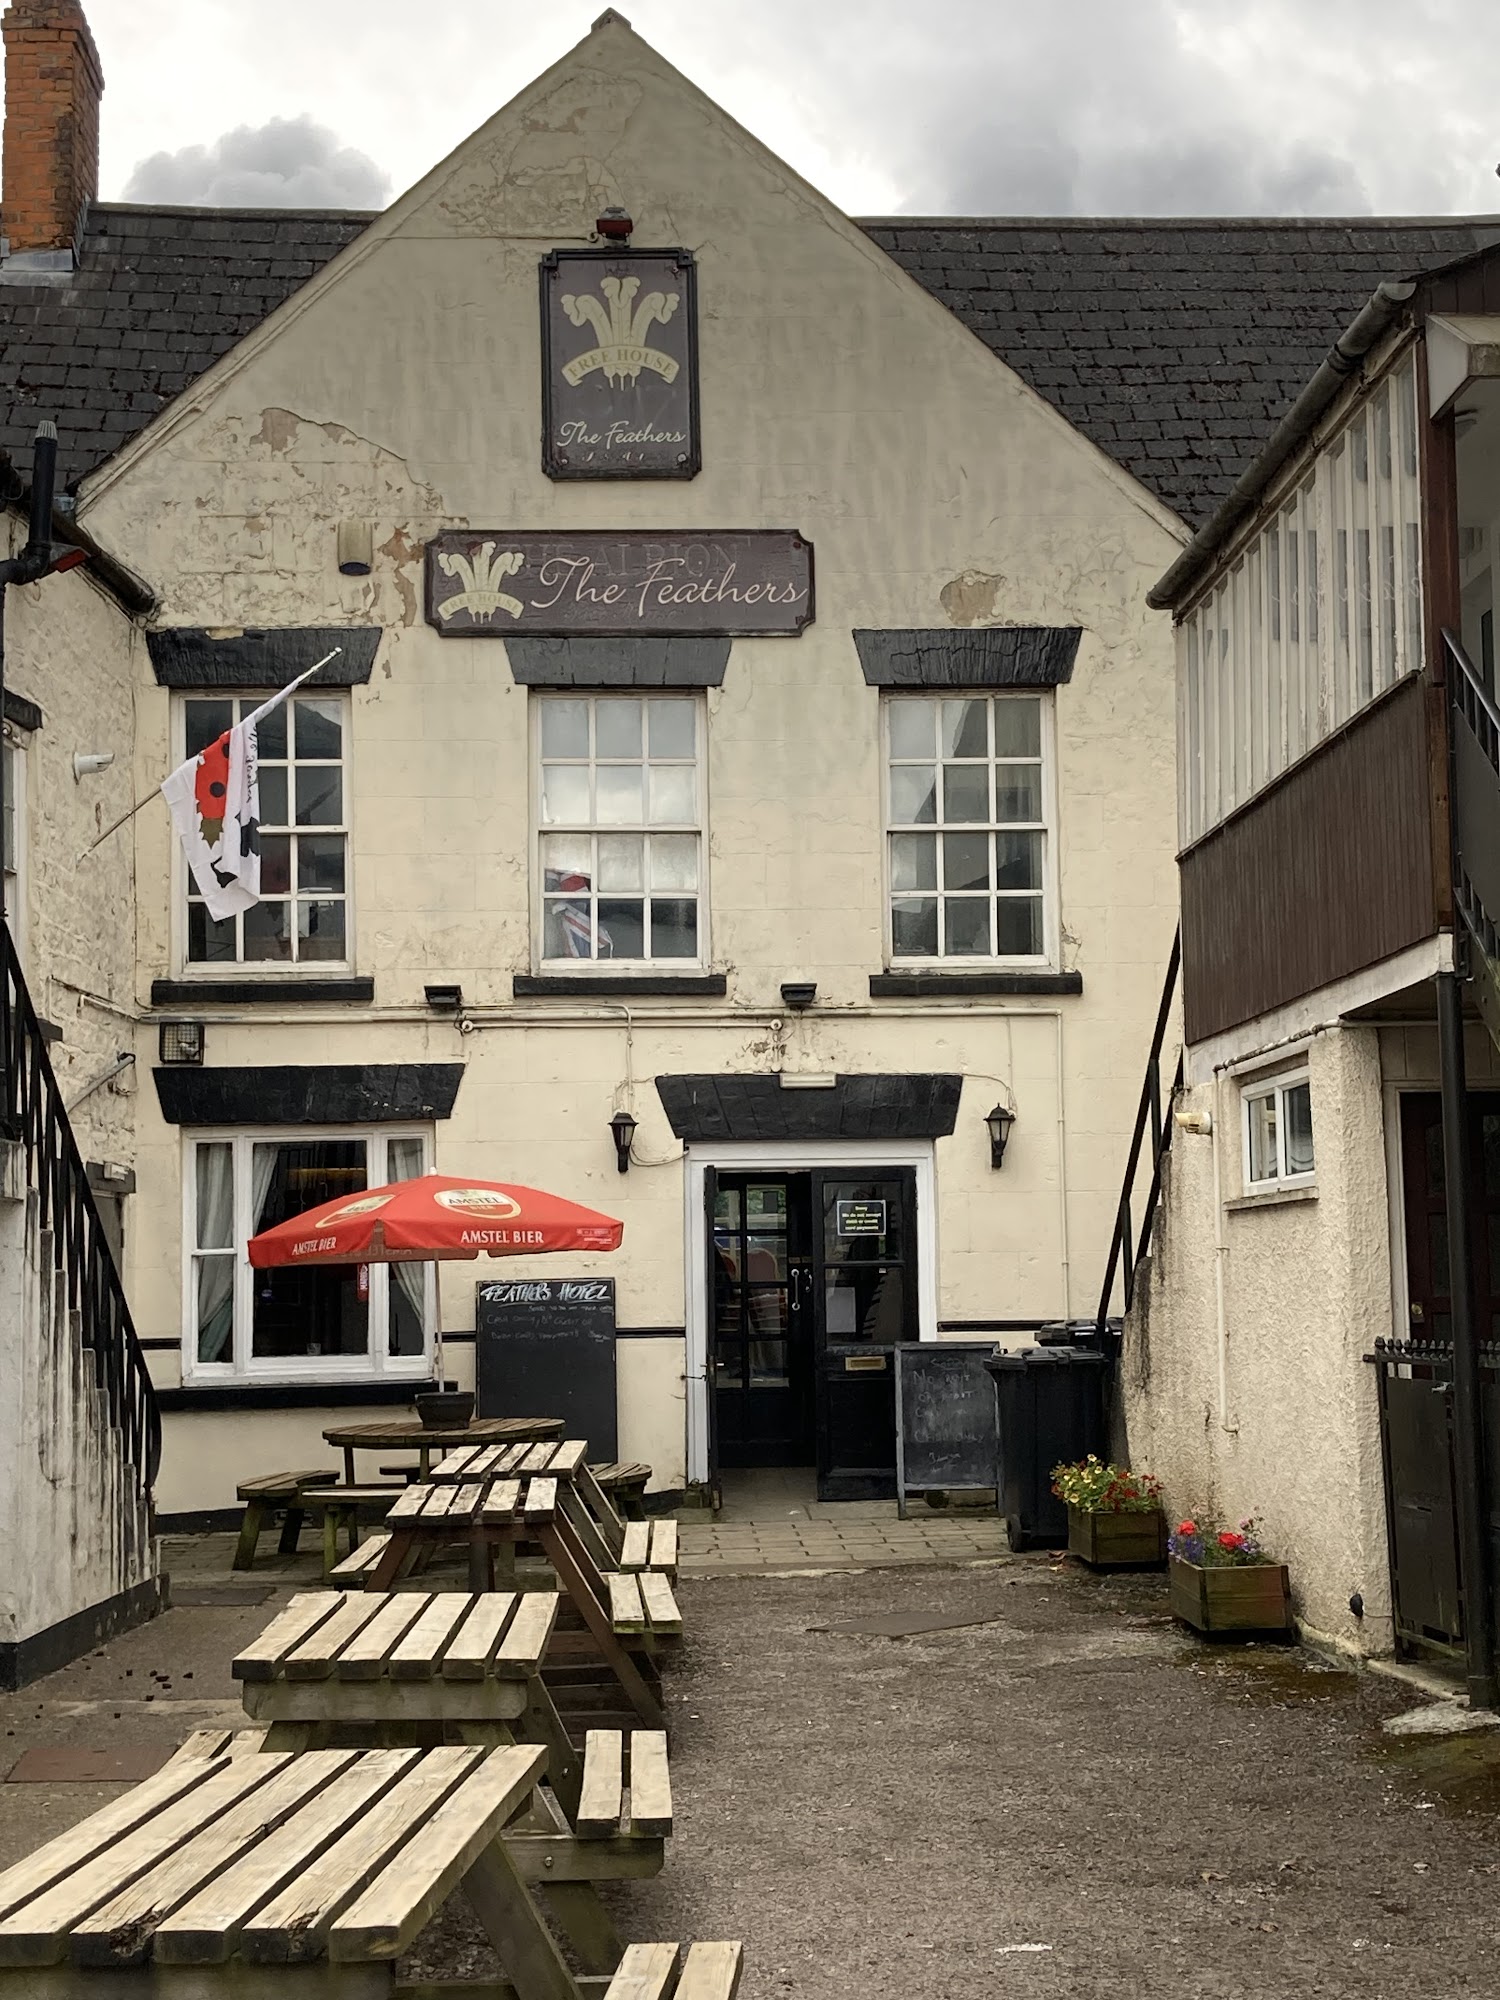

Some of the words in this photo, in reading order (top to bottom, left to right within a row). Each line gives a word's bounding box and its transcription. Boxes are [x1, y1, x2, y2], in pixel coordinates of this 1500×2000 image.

[567, 350, 611, 378] FREE
[617, 349, 676, 378] HOUSE
[556, 420, 602, 447] The
[605, 420, 686, 450] Feathers
[530, 556, 627, 609] The
[635, 557, 809, 618] Feathers
[443, 593, 475, 615] FREE
[478, 592, 521, 615] HOUSE
[448, 1196, 504, 1205] AMSTEL
[291, 1239, 318, 1256] AMSTEL
[318, 1236, 337, 1252] BIER
[461, 1230, 511, 1244] AMSTEL
[513, 1230, 545, 1244] BIER
[480, 1282, 552, 1302] FEATHERS
[556, 1281, 611, 1301] HOTEL
